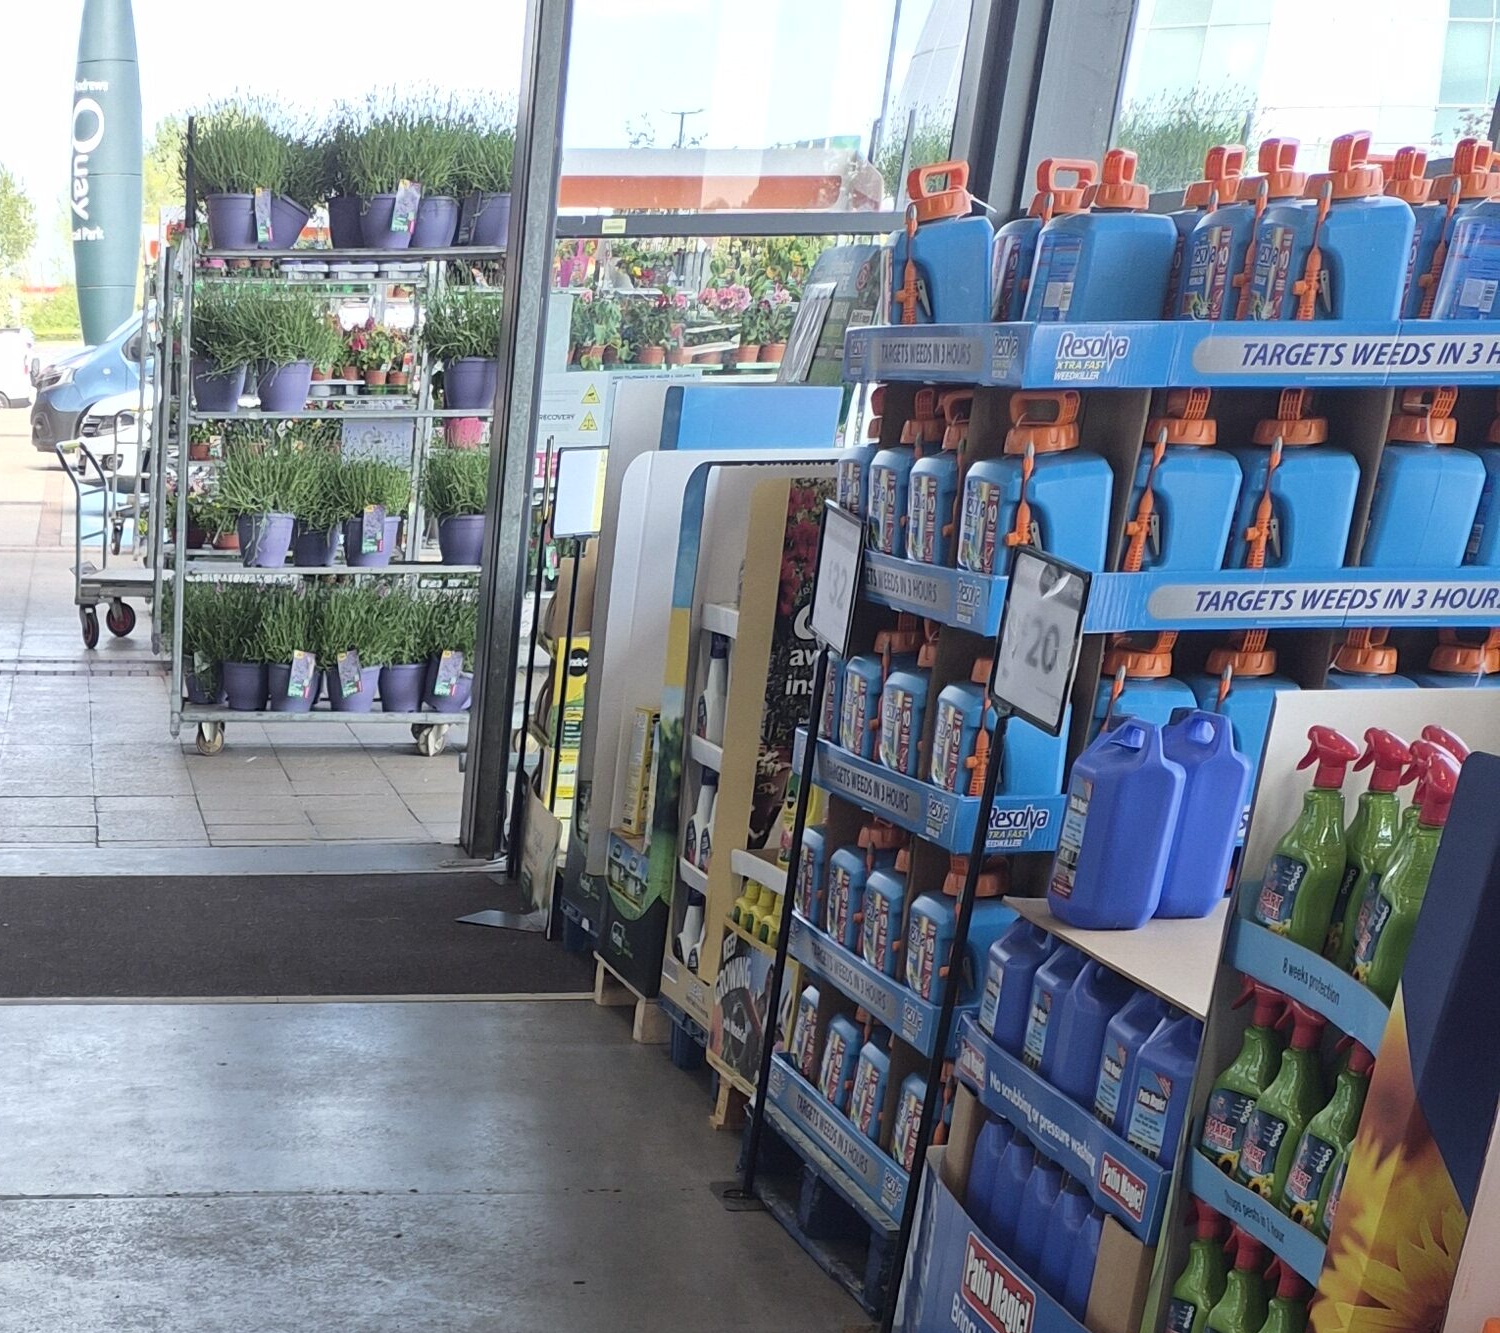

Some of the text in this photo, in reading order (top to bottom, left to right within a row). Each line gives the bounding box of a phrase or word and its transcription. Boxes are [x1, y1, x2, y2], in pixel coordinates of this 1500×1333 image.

[72, 97, 105, 222] Quay
[881, 343, 909, 364] TARGETS
[910, 344, 932, 364] WEEDS
[933, 344, 940, 364] IN
[946, 343, 971, 365] HOURS
[1056, 330, 1131, 373] Resolva
[1056, 361, 1107, 370] XTRA FAST
[1241, 342, 1348, 366] TARGETS
[1350, 342, 1436, 366] WEEDS
[1436, 342, 1466, 365] IN
[1466, 342, 1484, 364] 3
[1054, 371, 1100, 381] WEEDKILLER
[912, 575, 937, 603] HOURS
[1195, 589, 1296, 612] TARGETS
[1300, 588, 1381, 611] WEEDS
[1383, 588, 1411, 609] IN
[1412, 588, 1428, 609] 3
[851, 769, 874, 796] WEEDS
[874, 779, 880, 800] IN
[886, 782, 910, 813] HOURS
[988, 804, 1049, 841] Resolva
[988, 829, 1029, 839] TRA FAST
[985, 839, 1023, 848] EEDKILLER
[1288, 963, 1309, 985] weeks
[1308, 972, 1340, 1006] protection
[797, 1094, 819, 1127] TARGETS
[819, 1115, 838, 1144] WEEDS
[848, 1141, 868, 1175] HOURS
[989, 1070, 1096, 1177] No scrubbing or pressure washing
[1102, 1159, 1144, 1213] Patio Magic!
[964, 1244, 992, 1306] Patio
